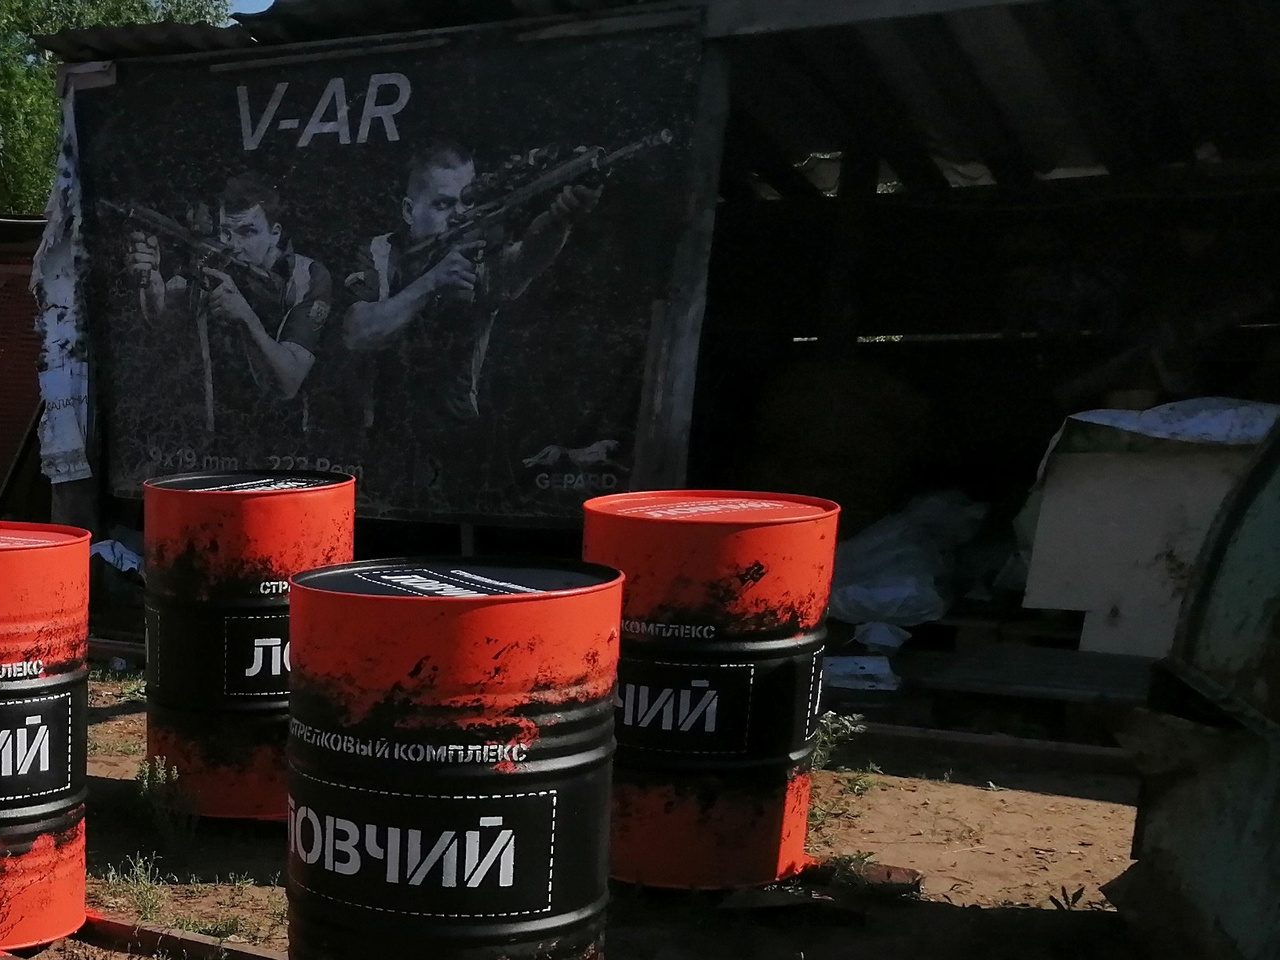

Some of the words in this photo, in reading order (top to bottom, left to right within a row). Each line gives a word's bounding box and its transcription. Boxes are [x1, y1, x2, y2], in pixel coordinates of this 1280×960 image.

[236, 73, 412, 150] V-AR
[535, 472, 618, 490] GEPARD
[260, 581, 290, 594] СТР
[621, 620, 716, 638] КОМПЛЕКС
[614, 680, 718, 732] ЧИЙ
[393, 742, 529, 763] КОМПЛЕКС
